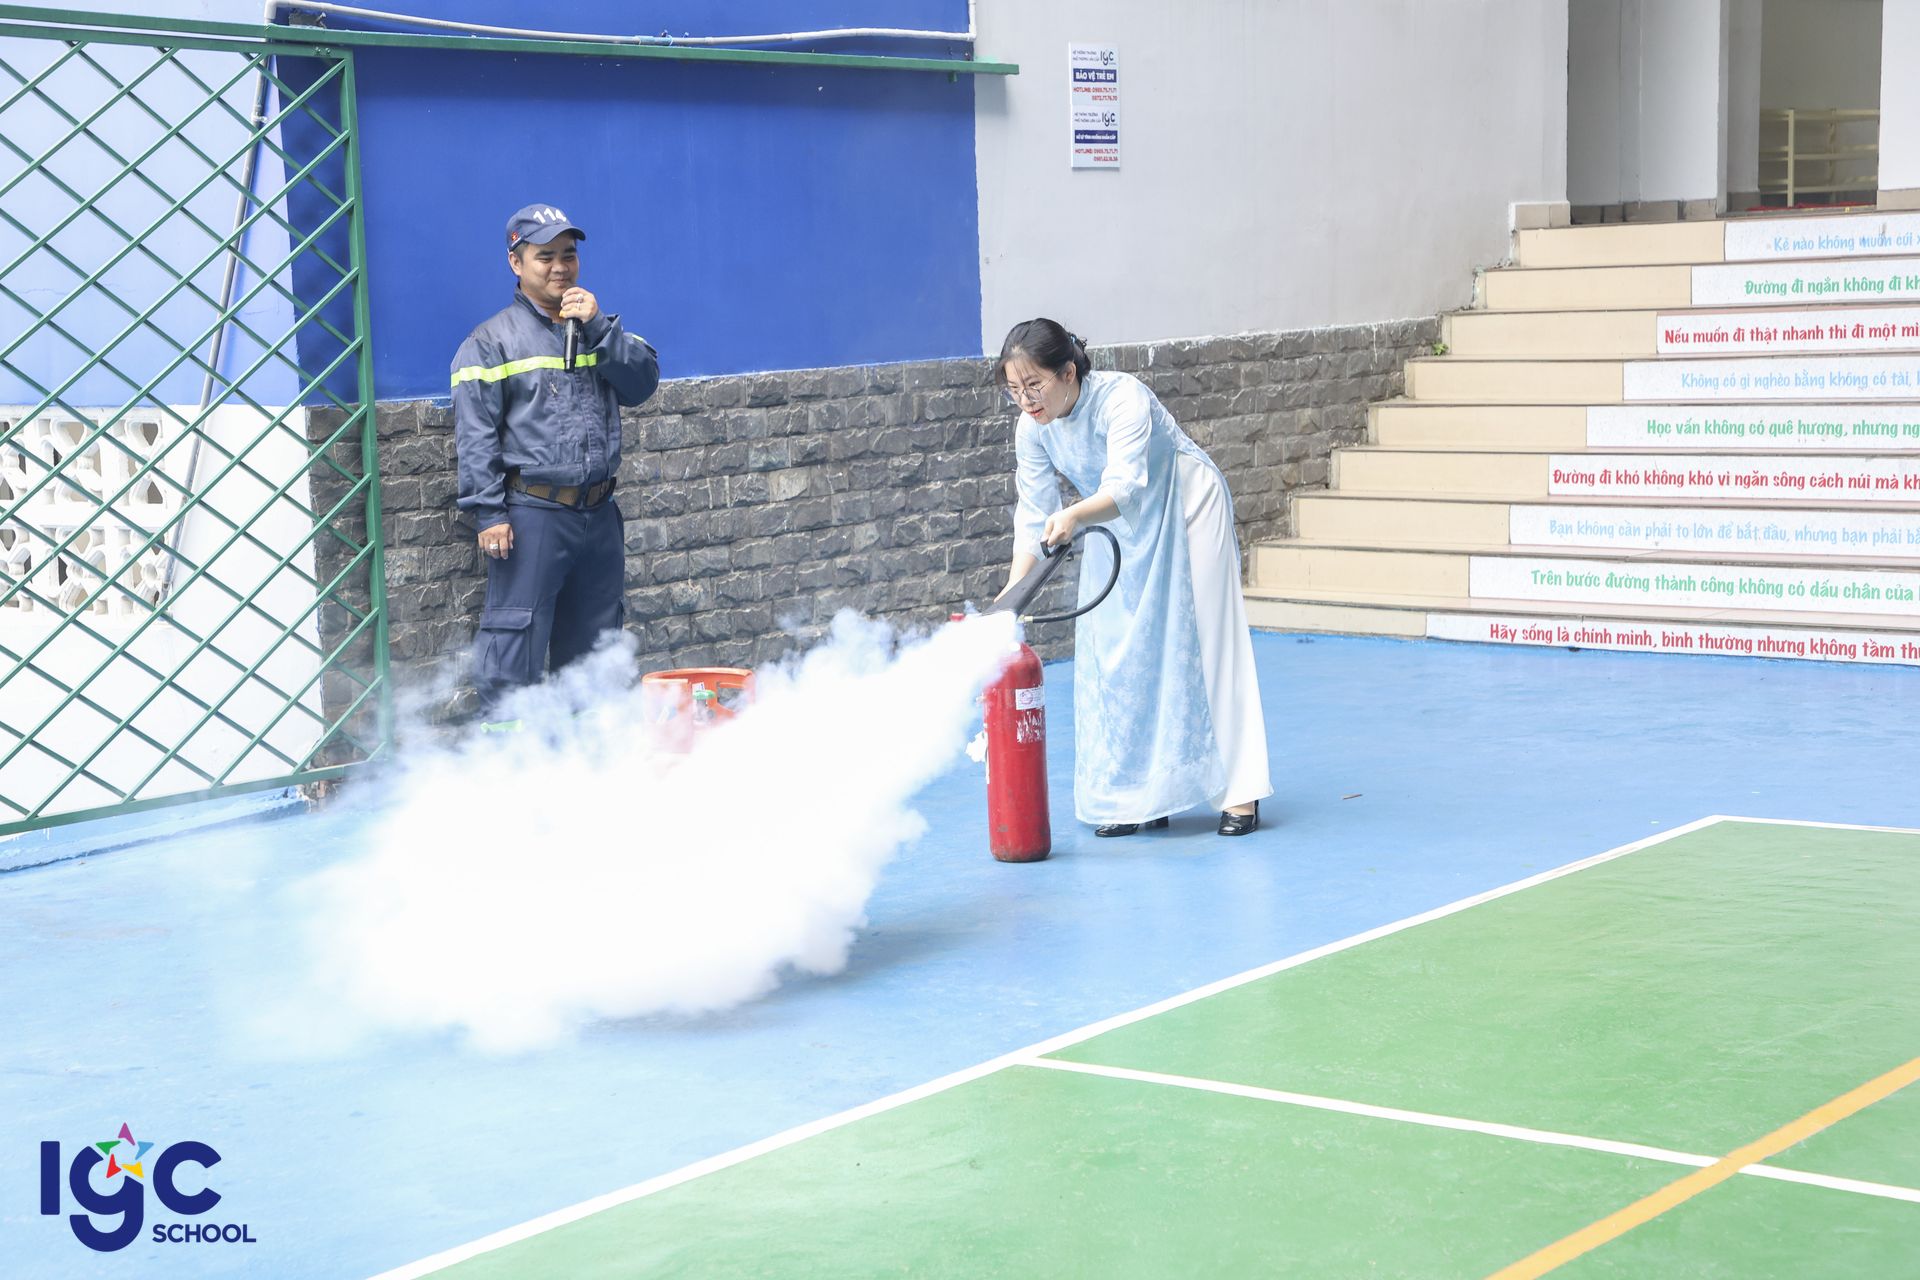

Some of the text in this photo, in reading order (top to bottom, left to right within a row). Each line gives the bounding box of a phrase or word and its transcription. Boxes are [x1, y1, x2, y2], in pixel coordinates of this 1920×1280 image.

[1075, 70, 1087, 80] BẢO
[1088, 71, 1096, 82] VỆ
[533, 207, 567, 224] 114
[1792, 237, 1814, 251] nào
[1818, 234, 1854, 251] không
[1744, 280, 1787, 296] Đường
[1791, 278, 1804, 293] đi
[1807, 276, 1839, 295] ngắn
[1843, 276, 1884, 294] không
[1888, 275, 1901, 290] đi
[1665, 327, 1689, 344] Nếu
[1693, 327, 1729, 343] muốn
[1733, 327, 1745, 342] đi
[1750, 327, 1777, 344] thật
[1782, 324, 1824, 341] nhanh
[1852, 323, 1864, 339] đi
[1869, 323, 1896, 341] một
[1681, 373, 1719, 390] Không
[1723, 372, 1736, 388] có
[1754, 373, 1790, 389] nghèo
[1829, 371, 1868, 388] không
[1872, 370, 1887, 386] có
[1647, 419, 1672, 438] Học
[1676, 417, 1700, 435] vấn
[1704, 419, 1745, 437] không
[1749, 419, 1765, 435] có
[1768, 419, 1793, 437] quê
[1852, 419, 1898, 438] nhưng
[1553, 469, 1595, 486] Đường
[1599, 469, 1611, 485] đi
[1616, 469, 1640, 485] khó
[1644, 470, 1684, 488] không
[1688, 470, 1713, 486] khó
[1734, 470, 1769, 488] ngăn
[1773, 471, 1805, 490] sông
[1809, 472, 1844, 488] cách
[1848, 472, 1871, 489] núi
[1549, 519, 1573, 538] Bạn
[1577, 519, 1614, 538] không
[1618, 519, 1641, 537] cần
[1645, 521, 1672, 540] phải
[1676, 523, 1689, 538] to
[1693, 523, 1713, 539] lớn
[1717, 521, 1735, 539] để
[1736, 521, 1759, 539] bắt
[1795, 525, 1838, 543] nhưng
[1842, 528, 1867, 546] bạn
[1872, 527, 1902, 546] phải
[1530, 570, 1562, 586] Trên
[1566, 571, 1601, 587] bước
[1605, 571, 1650, 592] đường
[1654, 574, 1696, 592] thành
[1700, 576, 1734, 596] công
[1739, 577, 1784, 598] không
[1788, 580, 1805, 596] có
[1809, 579, 1839, 598] dấu
[1843, 582, 1881, 600] chân
[1885, 584, 1914, 601] của
[1490, 623, 1517, 643] Hãy
[1522, 623, 1553, 644] sống
[1557, 627, 1570, 642] là
[1698, 633, 1753, 653] thường
[1757, 635, 1805, 656] nhưng
[1810, 639, 1857, 659] không
[1862, 638, 1895, 658] tầm
